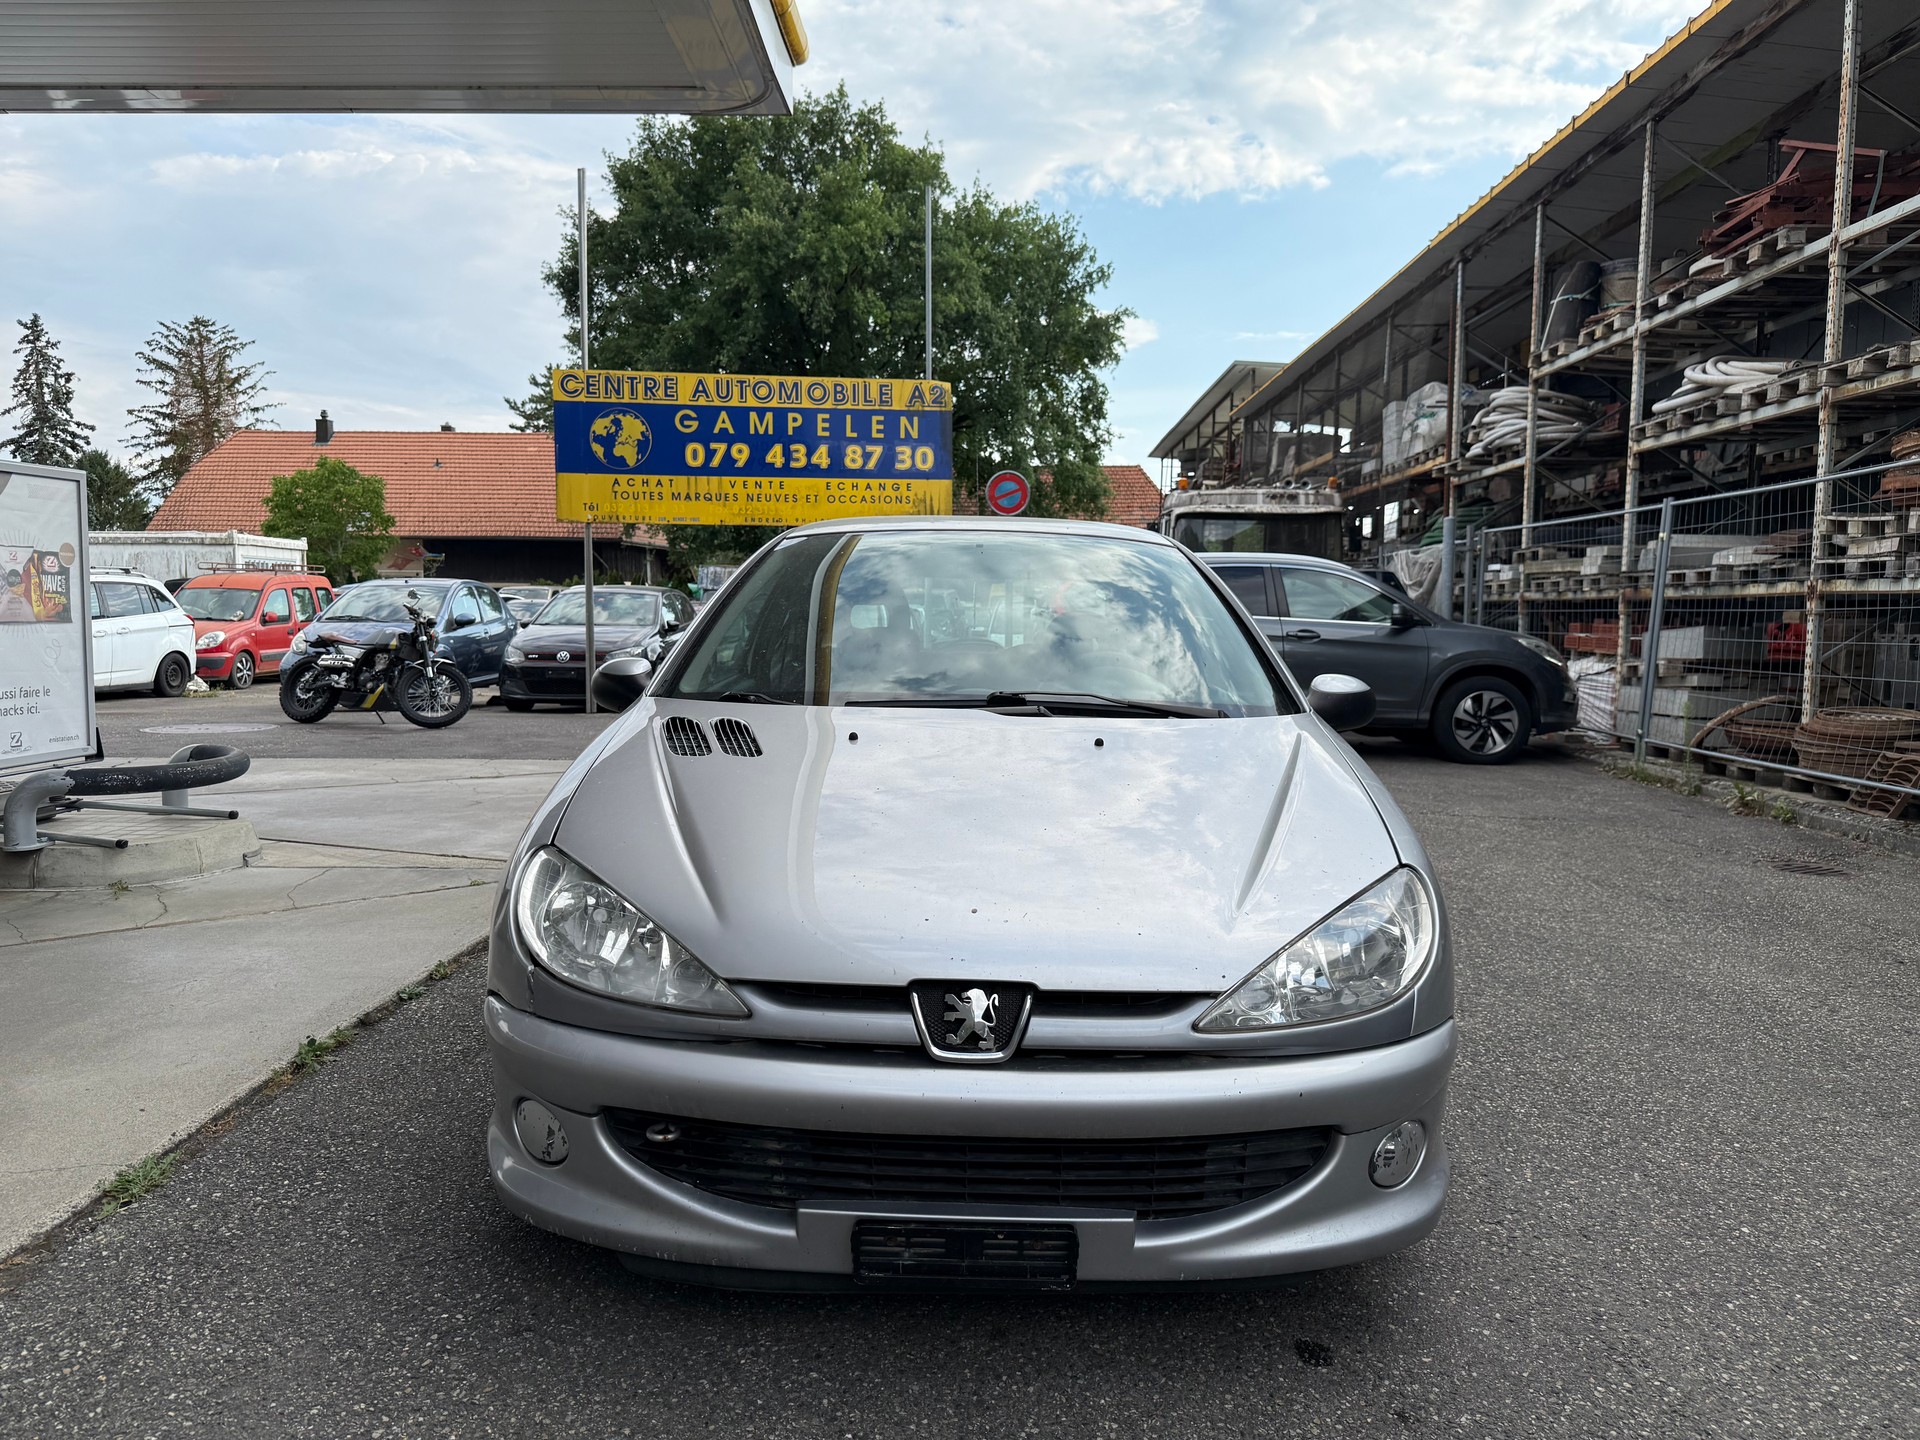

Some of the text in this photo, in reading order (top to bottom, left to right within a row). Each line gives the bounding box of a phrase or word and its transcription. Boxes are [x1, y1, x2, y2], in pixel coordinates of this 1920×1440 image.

[559, 373, 946, 407] CENTRE AUTOMOBILE A2
[674, 409, 919, 439] GAMPELEN
[685, 442, 935, 471] 079 434 87 30
[612, 478, 912, 492] ACHAT VENTE ECHANGE
[613, 490, 911, 504] TOUTES MARQUES NEUVES ET OCCASIONS
[583, 502, 599, 512] Tél
[19, 686, 41, 699] faire
[43, 685, 51, 697] le
[27, 702, 40, 715] ici.
